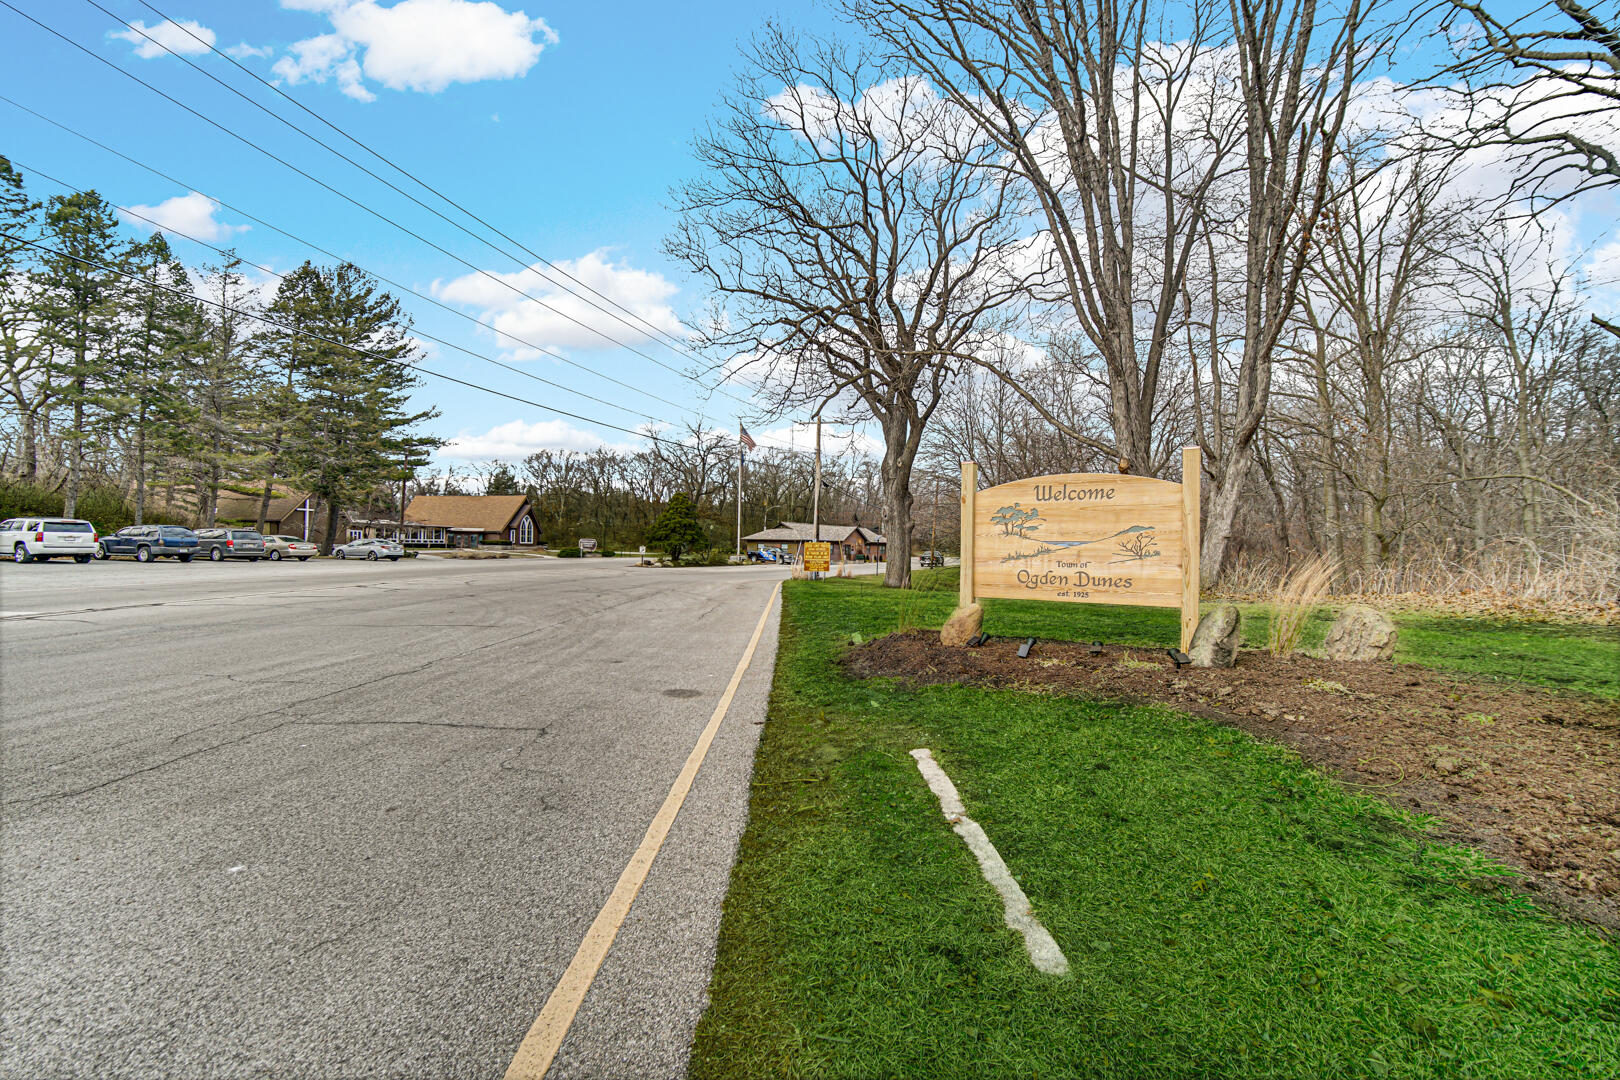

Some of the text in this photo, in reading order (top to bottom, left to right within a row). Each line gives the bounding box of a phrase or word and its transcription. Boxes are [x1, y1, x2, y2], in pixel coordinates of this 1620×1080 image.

[1034, 484, 1115, 501] Welcome
[1056, 560, 1078, 568] Town
[1017, 569, 1133, 589] Ogden Dunes
